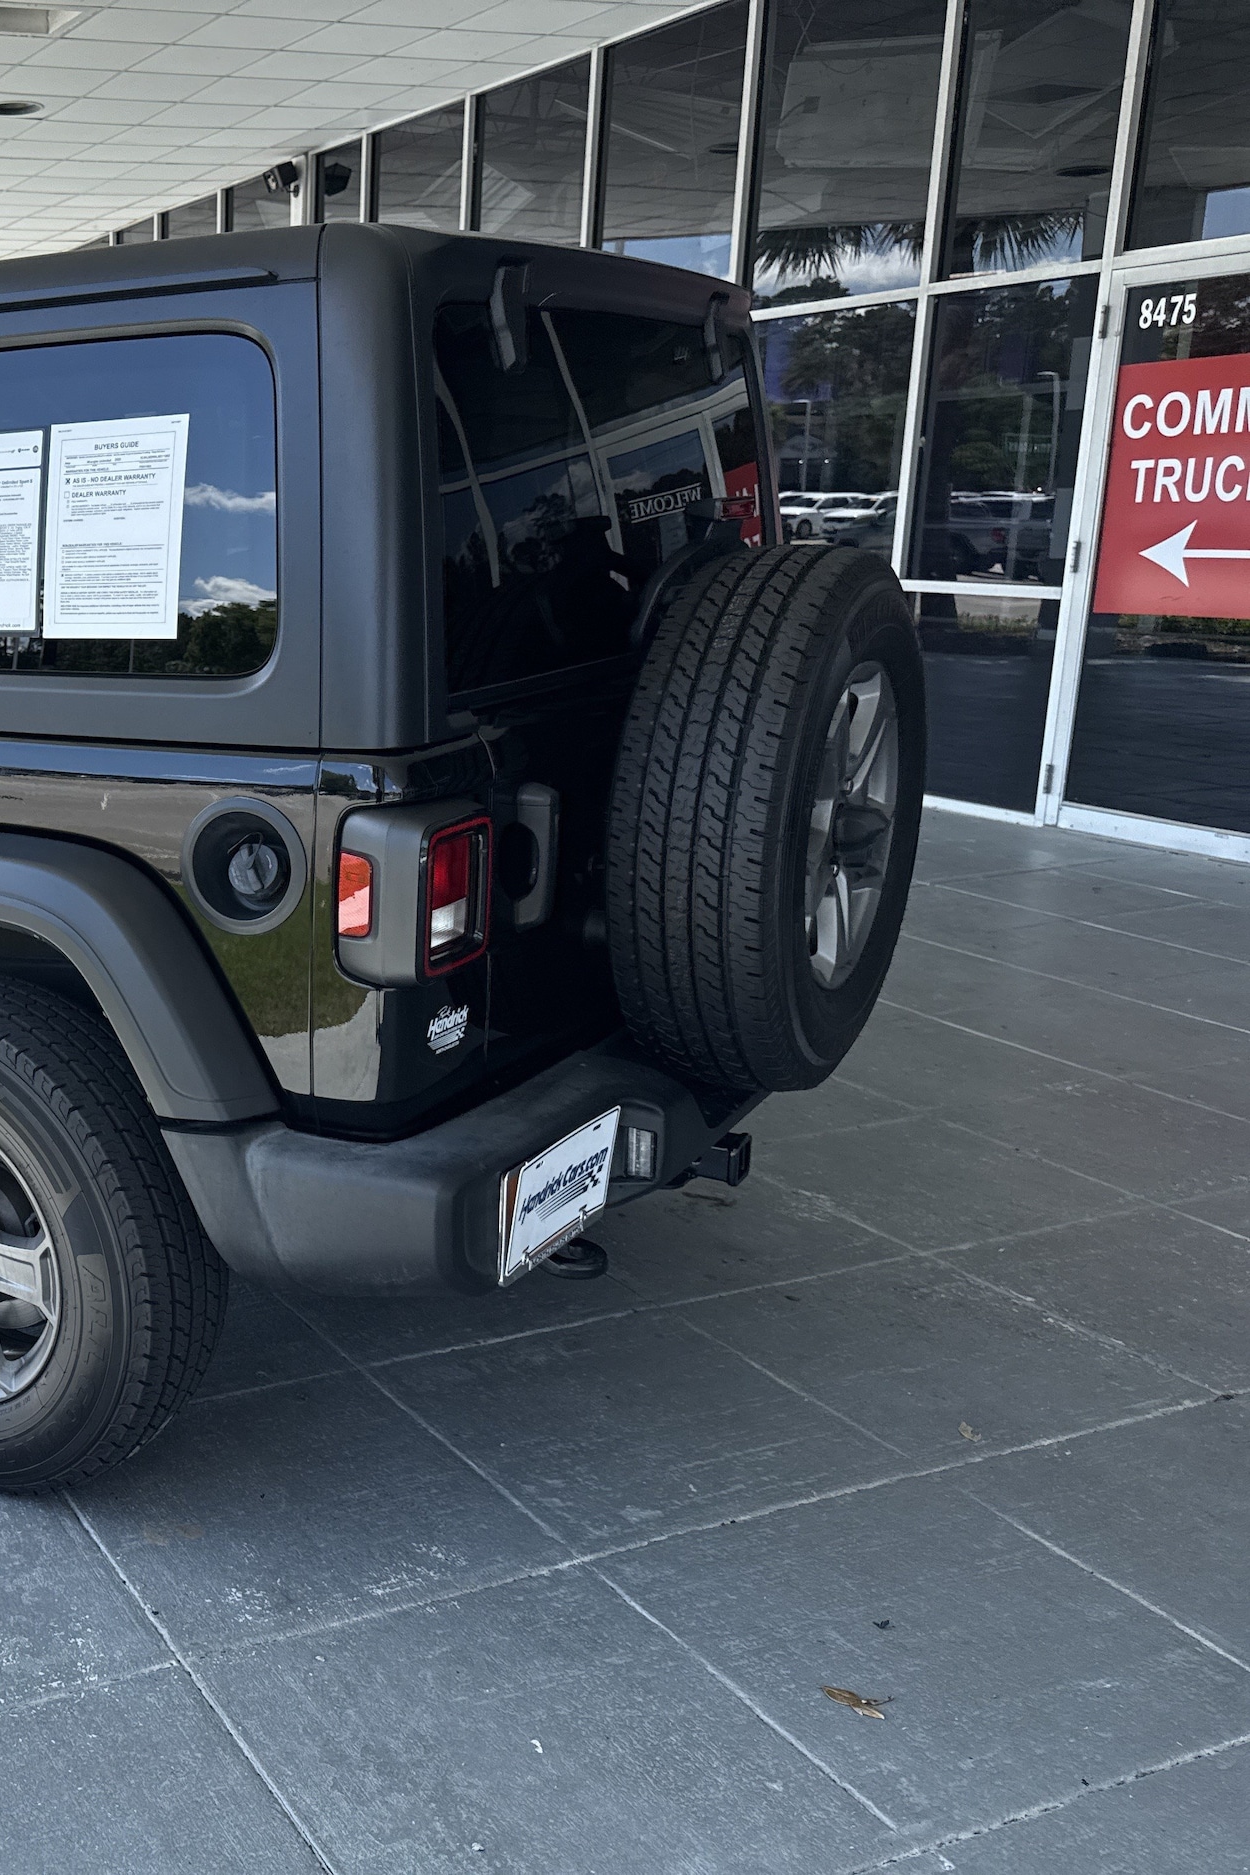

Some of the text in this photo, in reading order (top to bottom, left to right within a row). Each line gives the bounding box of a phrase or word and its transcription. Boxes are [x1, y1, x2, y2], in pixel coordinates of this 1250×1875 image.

[1139, 293, 1197, 329] 8475
[94, 441, 139, 451] BUYERS GUIDE
[100, 475, 122, 483] DEALER
[123, 473, 156, 481] WARRANTY
[1131, 455, 1250, 503] TRUC
[94, 489, 127, 497] WARRANTY
[427, 1004, 469, 1041] Hendrick
